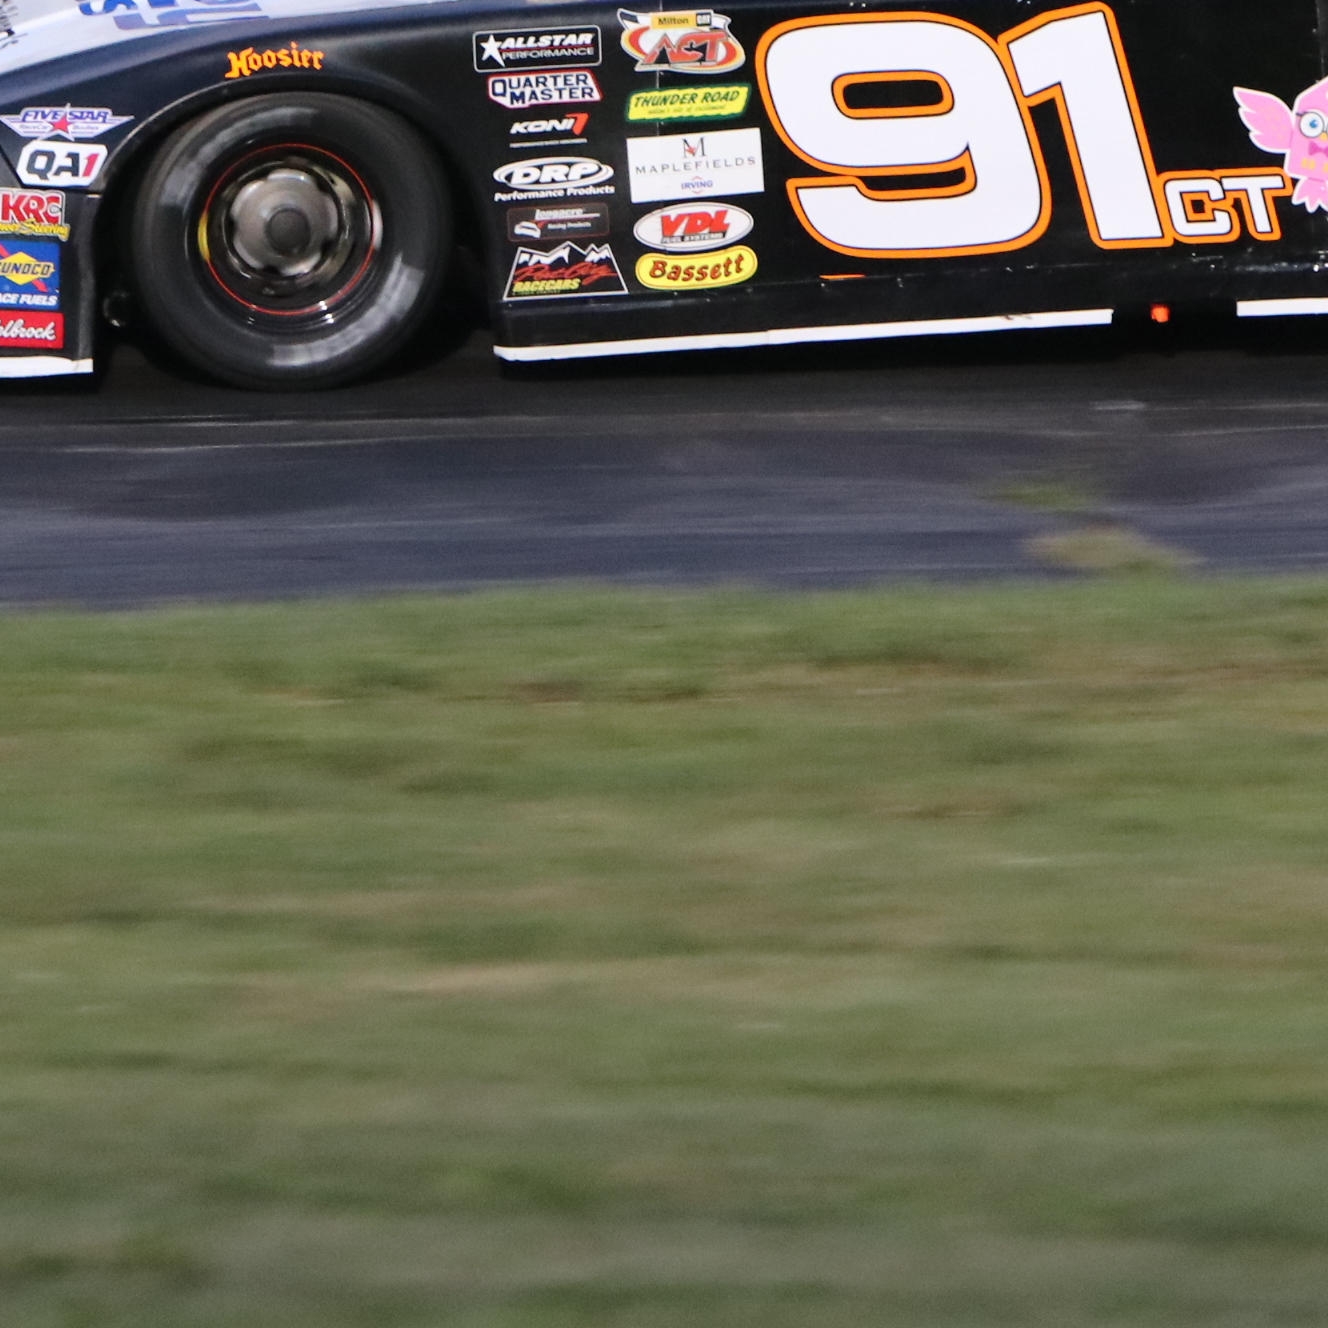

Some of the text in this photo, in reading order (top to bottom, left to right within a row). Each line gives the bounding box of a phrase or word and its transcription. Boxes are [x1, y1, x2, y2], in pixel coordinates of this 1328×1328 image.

[657, 16, 690, 26] Milton
[499, 32, 595, 50] ALLSTAR
[642, 30, 729, 66] ACT
[225, 41, 325, 78] Hoosier
[501, 46, 595, 61] PERFORMANCE
[491, 72, 589, 98] QUARTER
[509, 86, 595, 106] MASTER
[633, 90, 741, 109] THUNDER ROAD
[21, 108, 110, 123] FIVE STAR
[509, 117, 578, 135] KONI
[759, 4, 1289, 256] 91 CT
[26, 149, 100, 181] QA1
[509, 162, 600, 185] DRP
[634, 156, 757, 175] MAPLEFIELDS
[493, 184, 616, 203] Performance Products
[681, 180, 714, 190] IRVING
[0, 192, 63, 224] KRC
[19, 219, 71, 241] Steering
[660, 209, 731, 238] VDL
[648, 253, 745, 283] Bassett
[512, 277, 582, 293] RACECARS
[20, 292, 59, 307] FUELS
